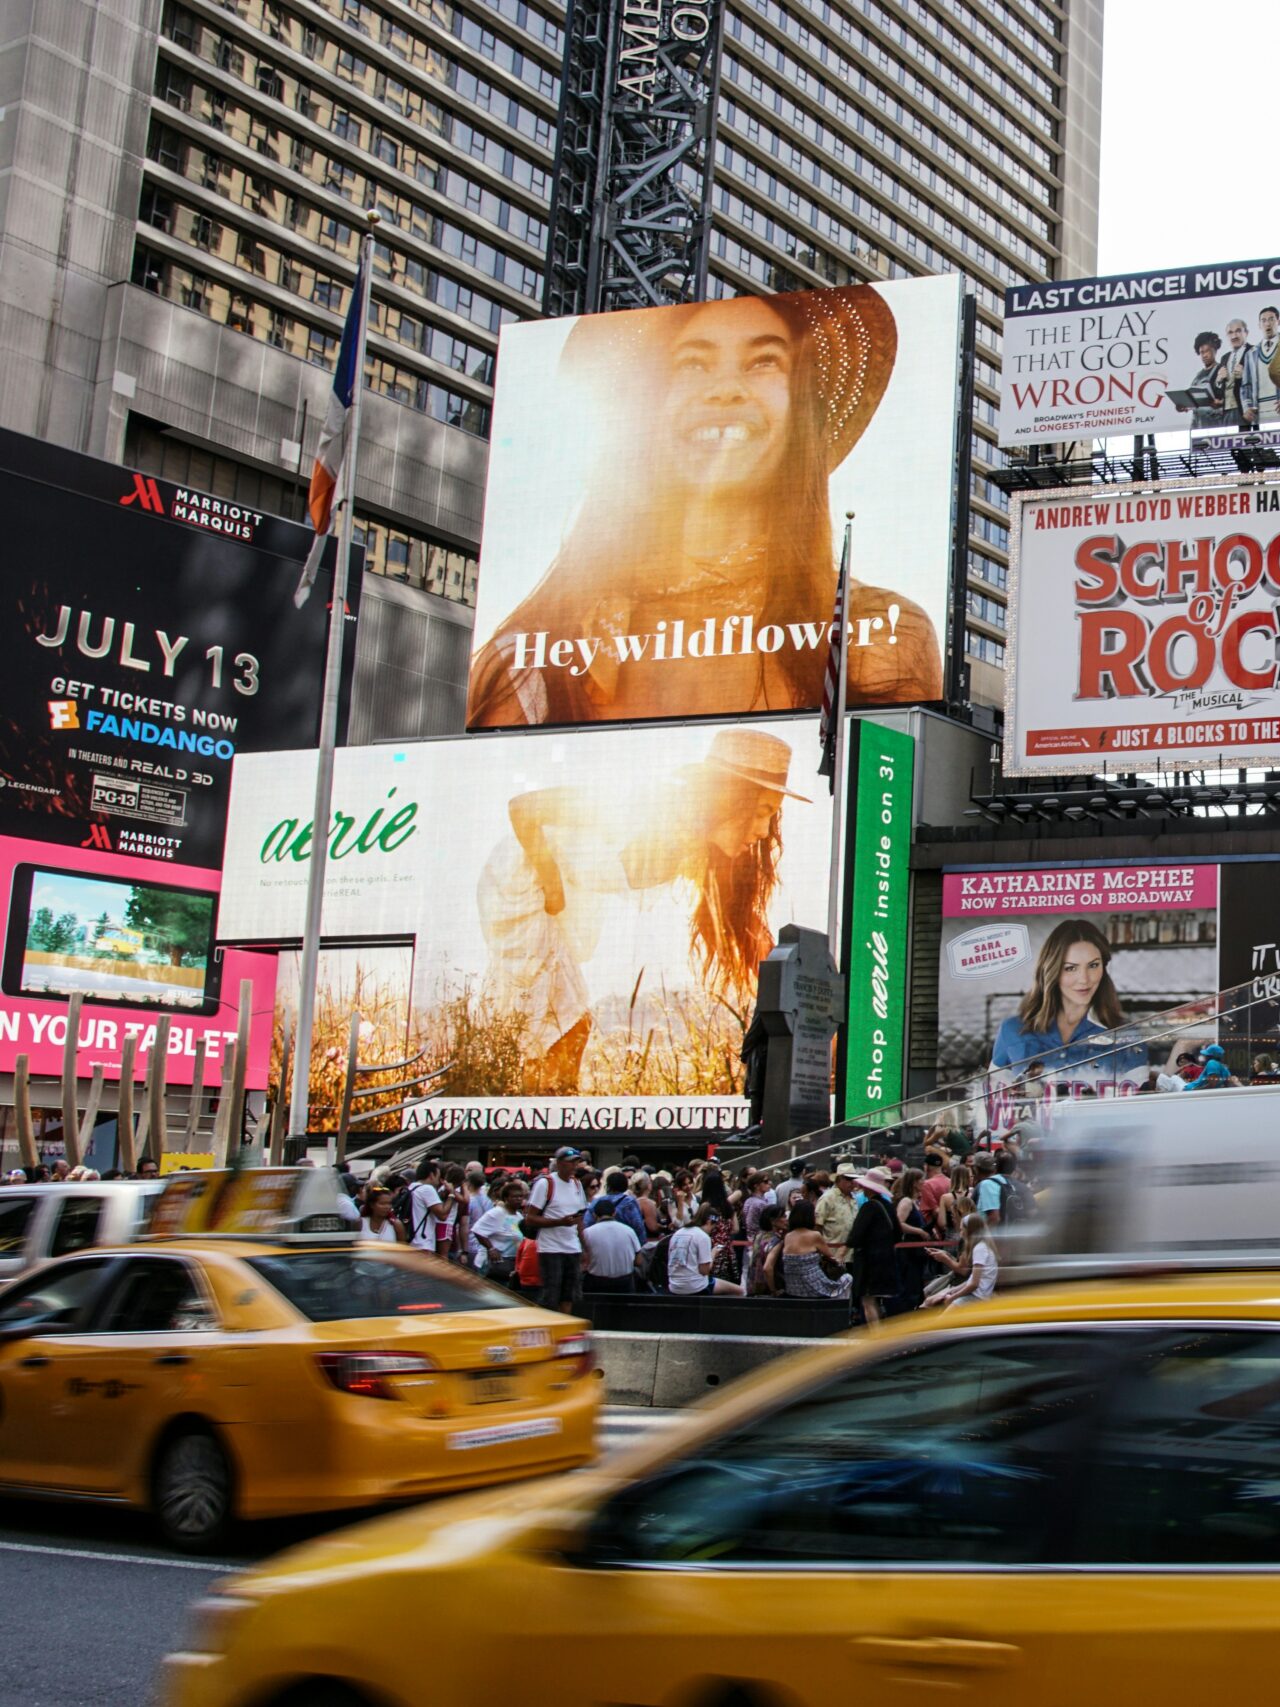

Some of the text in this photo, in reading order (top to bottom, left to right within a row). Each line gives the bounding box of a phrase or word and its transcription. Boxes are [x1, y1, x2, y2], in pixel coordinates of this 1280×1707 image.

[1013, 287, 1074, 311] LAST
[1078, 274, 1186, 305] CHANCE!
[1195, 267, 1264, 292] MUST
[1026, 310, 1157, 346] THE PLAY
[1013, 337, 1169, 374] THAT GOES
[1010, 372, 1169, 411] WRONG
[1033, 416, 1132, 432] LONGEST-RUNNING
[1136, 416, 1154, 424] PLAY
[1034, 406, 1136, 423] BROADWAY'S FUNNIEST
[174, 505, 250, 538] MARQUIS
[176, 489, 263, 526] MARRIOTT
[1116, 498, 1171, 523] LLOYD
[1174, 492, 1250, 518] WEBBER
[1188, 581, 1246, 637] of
[35, 604, 260, 696] JULY 13
[512, 631, 600, 676] Hey
[51, 677, 238, 732] GET TICKETS NOW
[1179, 691, 1244, 710] THE MUSICAL
[86, 710, 235, 760] FANDANGO
[1112, 729, 1149, 747] JUST
[1154, 728, 1163, 745] 4
[1167, 724, 1224, 744] BLOCKS
[1229, 723, 1247, 740] TO
[1252, 721, 1279, 739] THE
[68, 748, 77, 758] IN
[78, 750, 112, 767] THEATERS
[113, 757, 128, 769] AND
[192, 773, 214, 786] 3D
[8, 782, 61, 796] LEGENDARY
[94, 788, 136, 808] PG-13
[260, 787, 418, 863] aerie
[881, 793, 894, 825] on
[119, 842, 174, 858] MARQUIS
[120, 830, 182, 848] MARRIOTT
[874, 836, 892, 918] inside
[961, 869, 1194, 895] KATHARINE McPHEE
[962, 890, 1194, 910] NOW STARRING ON BROADWAY
[961, 947, 1018, 966] BAREILLES
[974, 940, 1001, 953] SARA
[1252, 944, 1276, 970] IT
[867, 931, 890, 1019] aerie
[868, 1029, 887, 1100] Shop
[405, 1106, 550, 1130] AMERICAN
[560, 1106, 647, 1130] EAGLE
